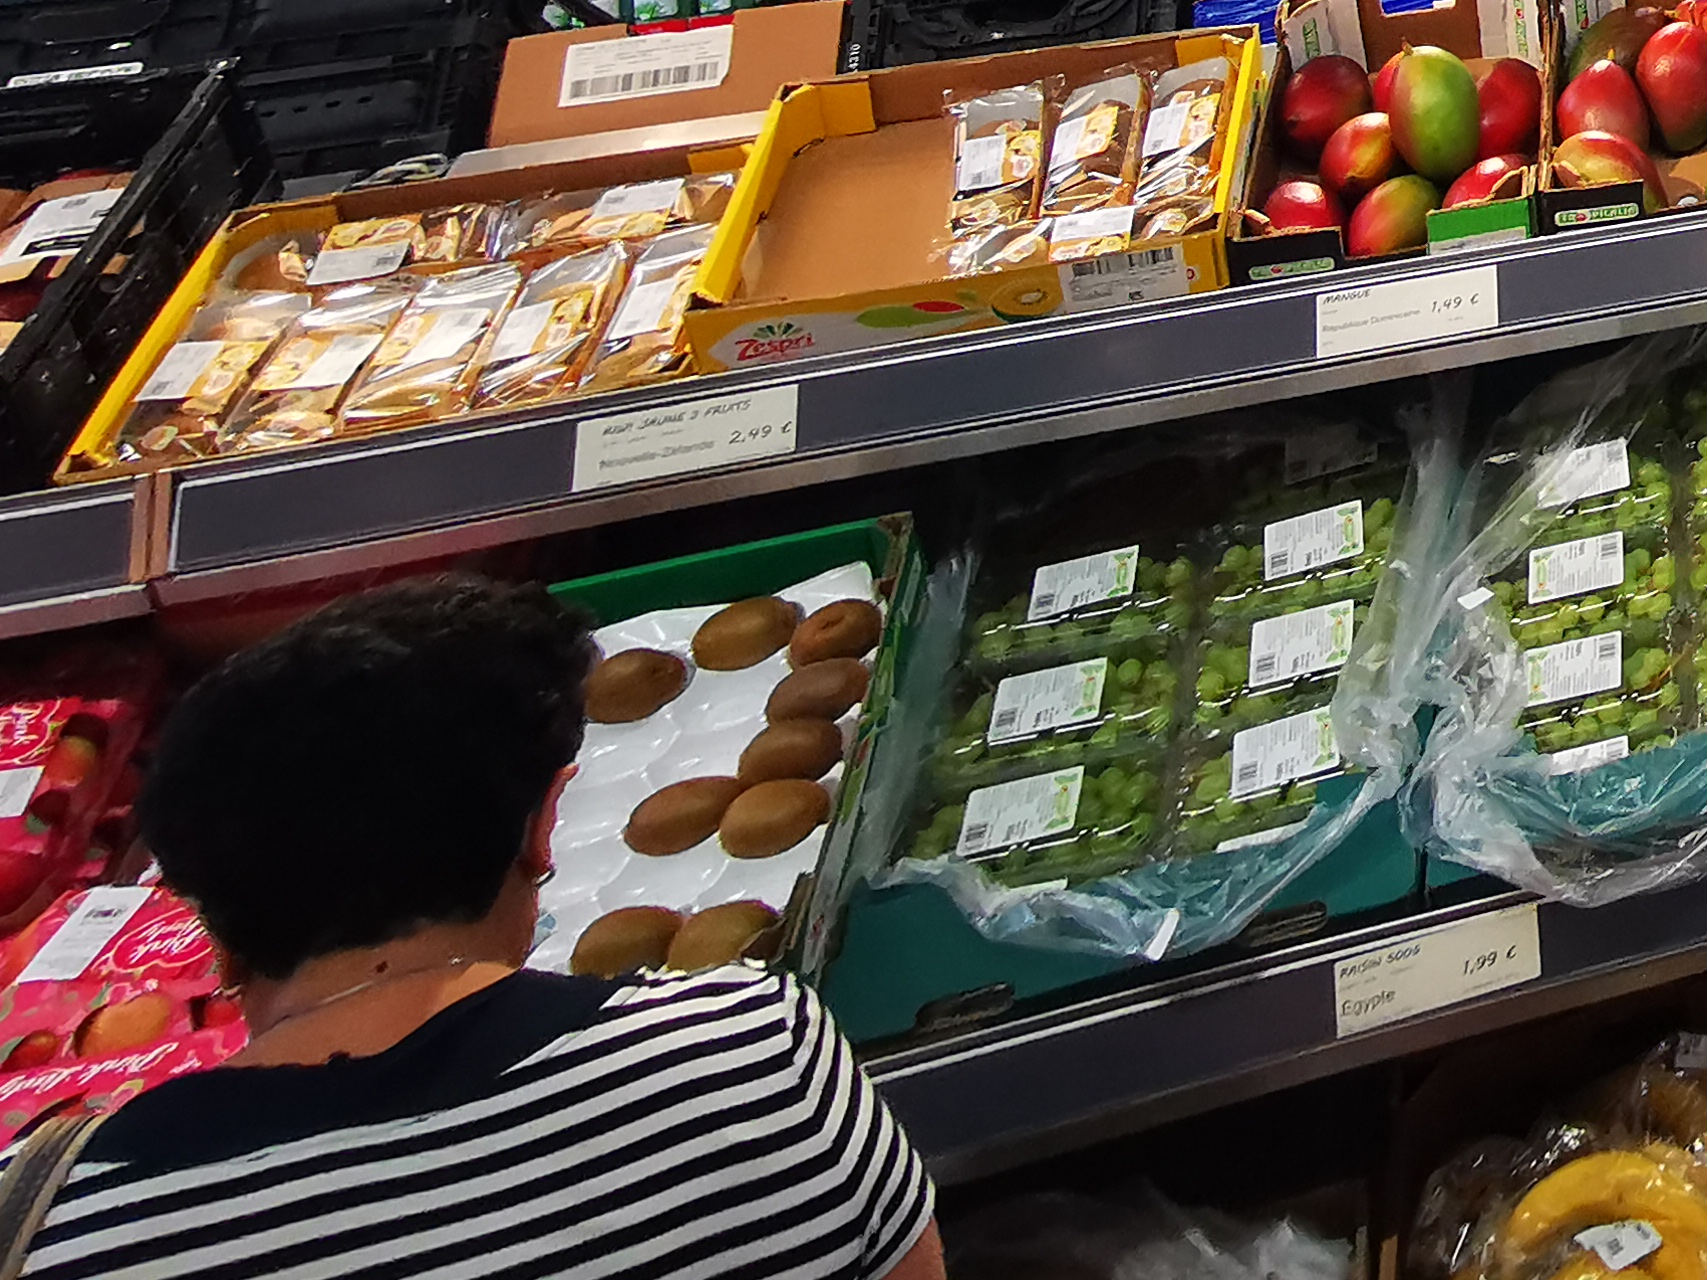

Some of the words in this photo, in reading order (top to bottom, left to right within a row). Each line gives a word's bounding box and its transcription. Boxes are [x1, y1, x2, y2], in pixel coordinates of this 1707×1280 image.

[1322, 288, 1372, 306] MANGUE
[1431, 295, 1462, 315] 1,49
[1470, 292, 1479, 306] €
[735, 332, 816, 362] Zespri
[729, 424, 773, 446] 2,49
[781, 420, 793, 435] €
[1463, 950, 1498, 977] 1,99
